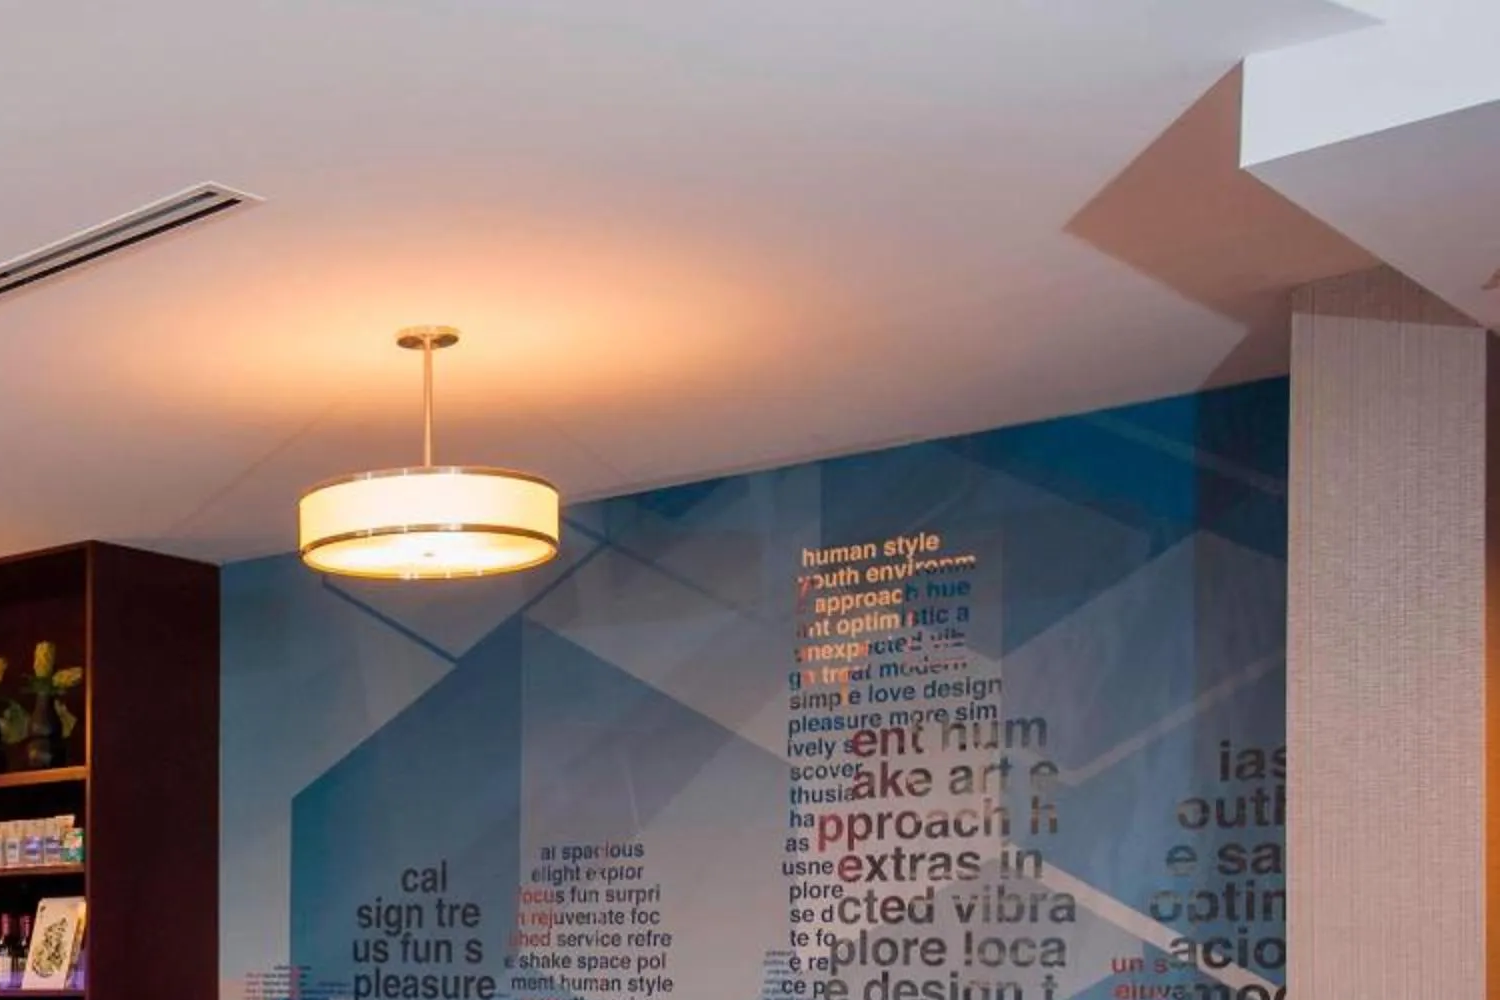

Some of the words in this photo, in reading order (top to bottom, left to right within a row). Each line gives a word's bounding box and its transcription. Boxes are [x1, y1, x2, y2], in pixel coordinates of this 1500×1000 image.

[802, 543, 877, 568] human
[883, 532, 941, 558] style
[797, 567, 860, 597] youth
[814, 584, 919, 616] approach
[927, 579, 972, 599] hue
[837, 604, 950, 639] optimistic
[956, 606, 971, 624] a
[869, 682, 916, 704] love
[923, 675, 1004, 703] design
[788, 710, 882, 738] pleasure
[888, 708, 949, 727] more
[955, 702, 999, 722] sim
[852, 723, 925, 758] ent
[940, 715, 1048, 752] hum
[790, 761, 865, 782] scover
[852, 760, 933, 799] ake
[949, 756, 1013, 796] art
[790, 783, 854, 805] thusia
[789, 808, 815, 828] ha
[817, 797, 1012, 852] pproach
[1029, 794, 1059, 836] h
[561, 841, 645, 864] spacious
[785, 836, 810, 852] as
[1216, 842, 1283, 876] sa
[401, 858, 448, 893] cal
[531, 865, 581, 887] elight
[782, 859, 834, 877] usne
[837, 846, 981, 884] extras
[1001, 840, 1043, 881] in
[570, 884, 600, 904] fun
[605, 883, 661, 907] surpri
[789, 881, 844, 903] plore
[837, 886, 936, 925] cted
[951, 884, 1076, 925] vibra
[355, 896, 424, 937] sign
[435, 898, 482, 929] tre
[531, 907, 625, 929] rejuvenate
[630, 907, 661, 926] foc
[790, 908, 815, 924] se
[821, 904, 834, 923] d
[353, 938, 390, 964] us
[400, 931, 454, 965] fun
[464, 937, 484, 965] s
[557, 929, 622, 948] service
[627, 929, 673, 948] refre
[790, 930, 810, 948] te
[816, 927, 837, 948] fo
[830, 928, 948, 976] plore
[519, 952, 572, 970] shake
[577, 953, 632, 973] space
[637, 952, 667, 974] pol
[789, 957, 802, 971] e
[808, 956, 830, 971] re
[511, 975, 555, 993] ment
[561, 973, 622, 992] human
[627, 975, 675, 997] style
[782, 979, 807, 995] ce
